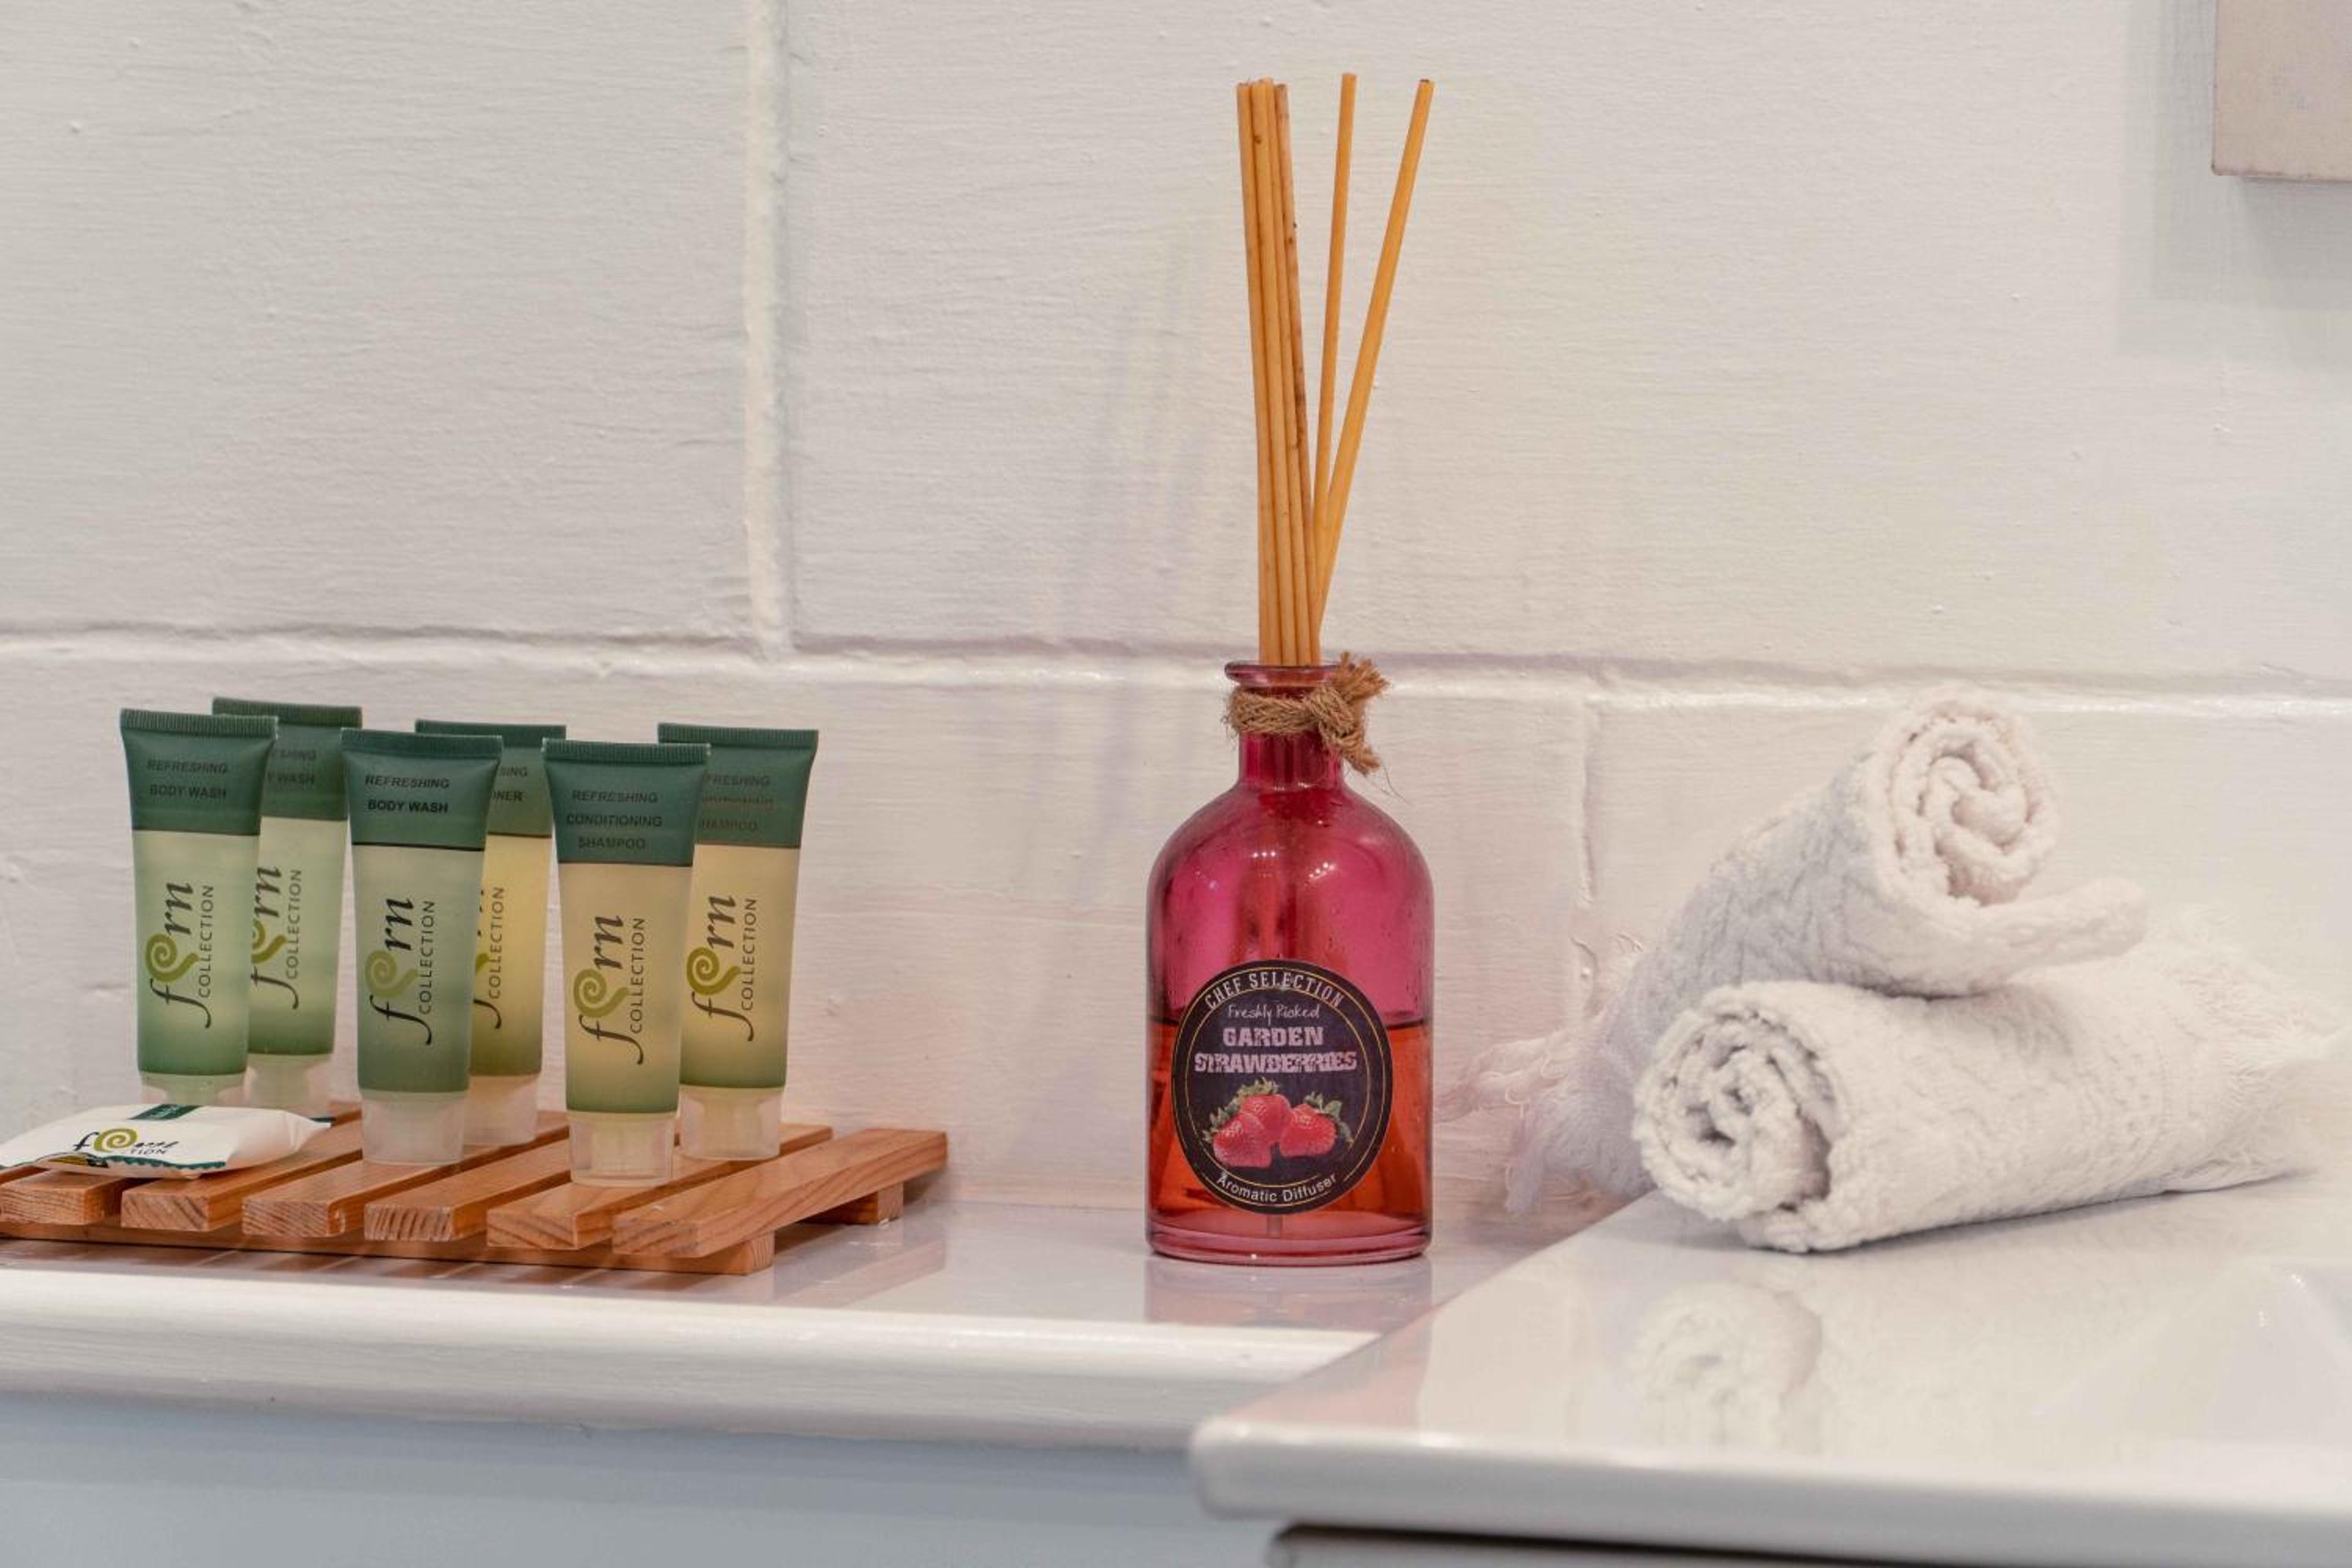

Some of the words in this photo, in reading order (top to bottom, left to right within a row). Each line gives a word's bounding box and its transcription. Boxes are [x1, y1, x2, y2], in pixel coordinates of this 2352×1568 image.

[147, 759, 227, 775] REFRESHING
[150, 784, 185, 797] BODY
[187, 786, 227, 800] WASH
[365, 775, 451, 789] REFRESHING
[368, 800, 405, 812] BODY
[408, 802, 449, 814] WASH
[572, 789, 659, 804] REFRESHING
[566, 815, 663, 827] CONDITIONING
[578, 837, 647, 850] SHAMPOO
[285, 869, 302, 980] COLLECTION
[198, 885, 214, 999] COLLECTION
[488, 887, 506, 1000] COLLECTION
[418, 900, 435, 1015] COLLECTION
[741, 898, 757, 1011] COLLECTION
[630, 917, 647, 1034] COLLECTION
[1204, 976, 1242, 1010] CHEF
[1249, 971, 1344, 1008] SELECTION
[1228, 1004, 1272, 1026] Freshly
[1276, 1004, 1320, 1018] Picked
[1222, 1026, 1324, 1047] GARDEN
[1193, 1051, 1357, 1073] STRAWBERRIES
[1216, 1175, 1278, 1203] Aromatic
[1282, 1174, 1338, 1203] Diffuser
